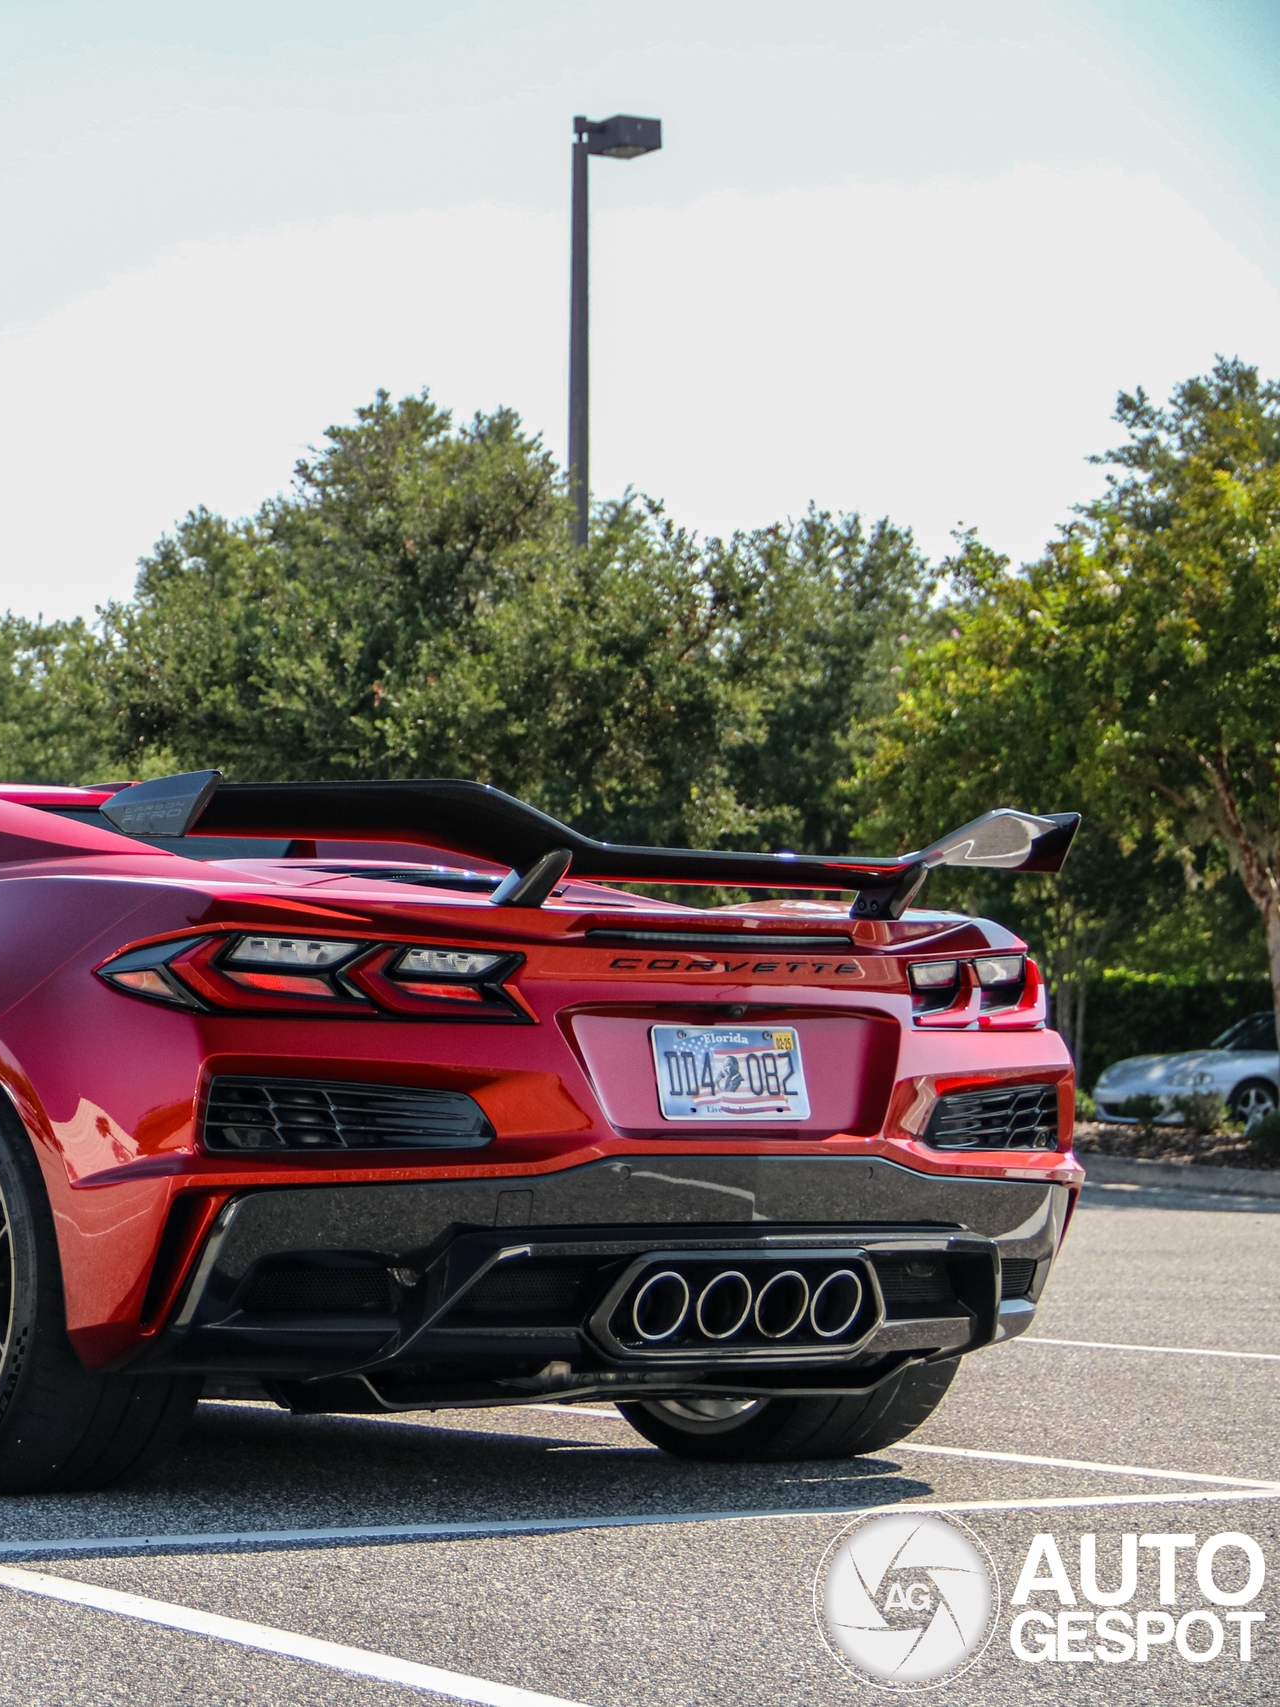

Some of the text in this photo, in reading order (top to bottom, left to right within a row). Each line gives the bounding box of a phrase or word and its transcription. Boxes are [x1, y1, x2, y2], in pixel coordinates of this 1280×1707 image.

[609, 958, 859, 975] CORVETTE
[703, 1032, 750, 1045] Florida
[664, 1051, 799, 1096] DD4 082
